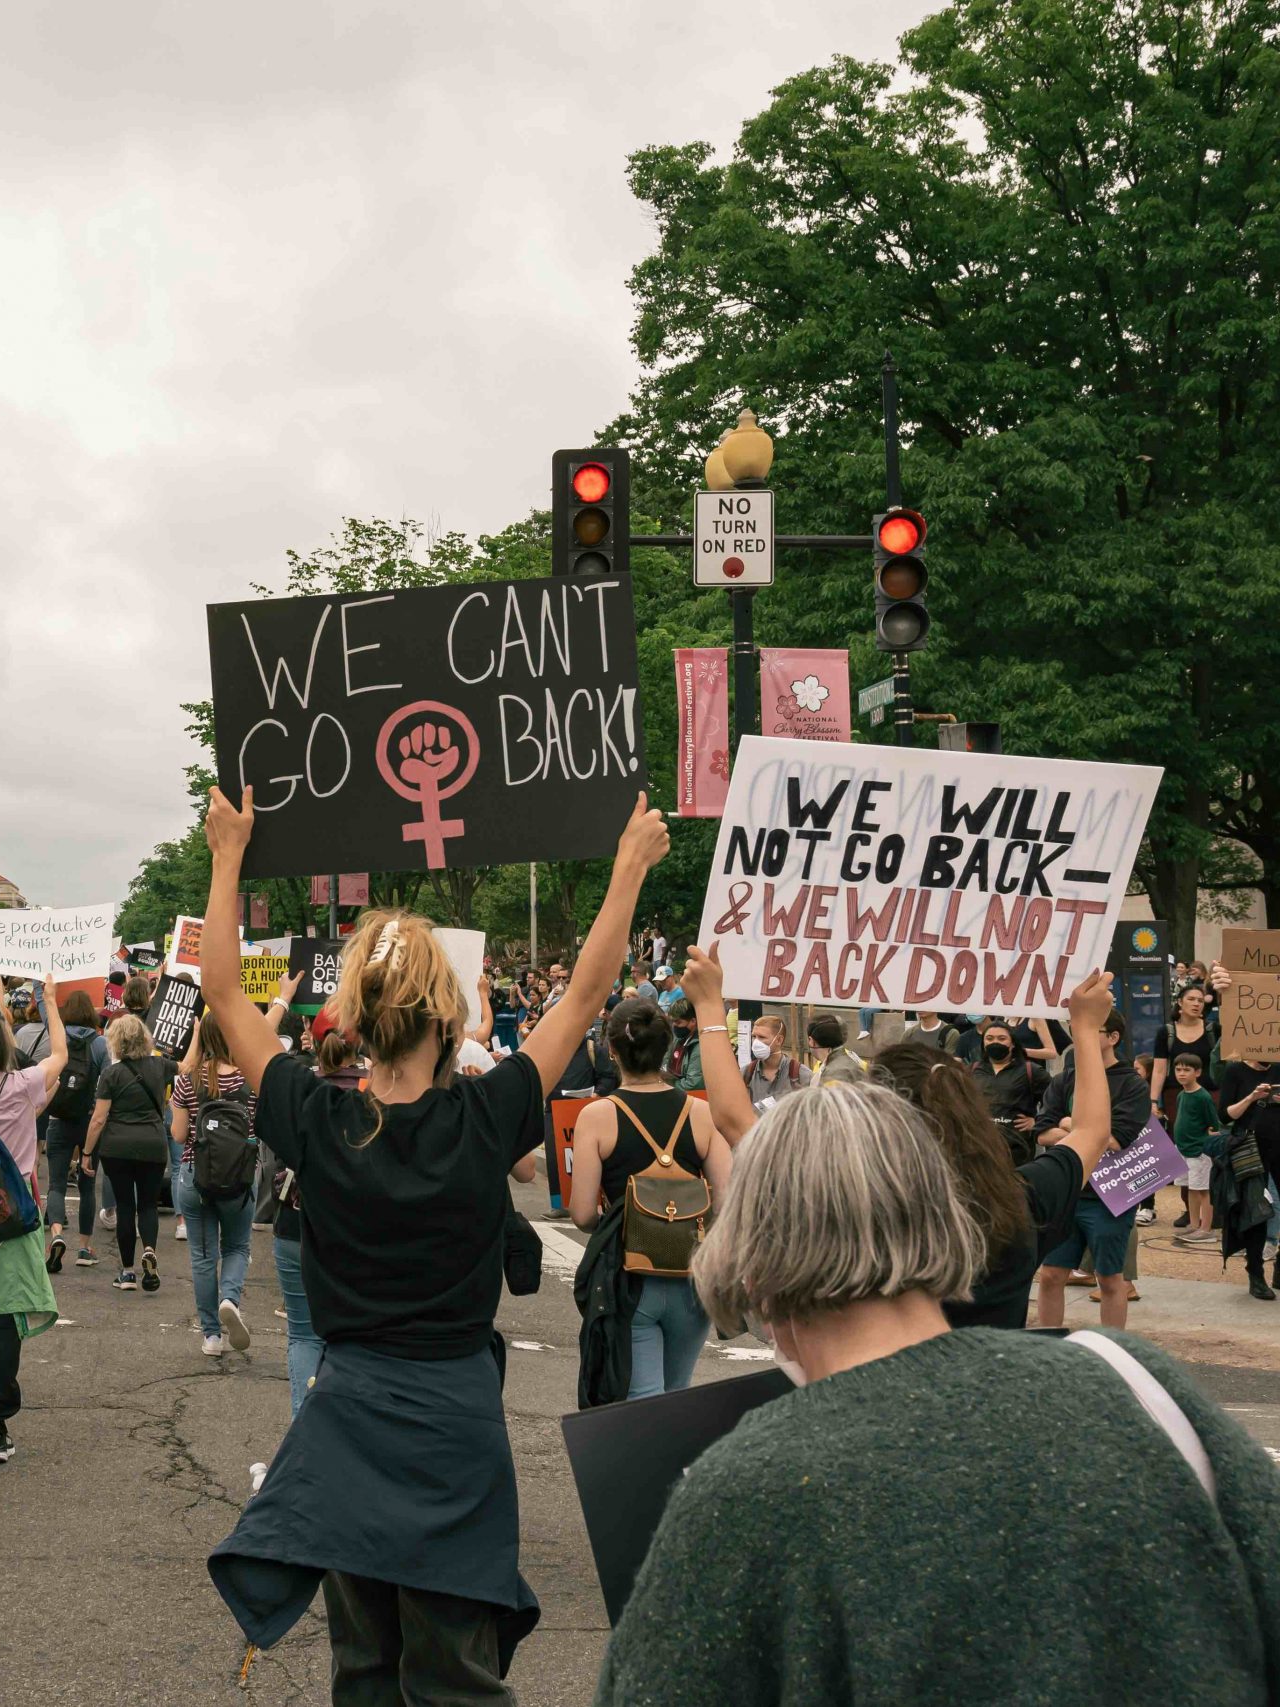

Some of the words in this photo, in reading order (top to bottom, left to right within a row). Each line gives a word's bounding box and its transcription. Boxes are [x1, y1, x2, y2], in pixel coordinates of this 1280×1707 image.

[719, 497, 751, 516] NO
[712, 520, 757, 535] TURN
[702, 539, 727, 554] ON
[733, 538, 766, 553] RED
[240, 595, 403, 709] WE
[448, 581, 620, 684] CAN'T
[685, 662, 693, 804] NationalCherryBlossomFestival.org
[773, 723, 803, 736] Cherry
[803, 724, 842, 734] Blossom
[239, 712, 351, 812] GO
[499, 684, 638, 786] BACK!
[787, 776, 893, 833] WE
[940, 785, 1077, 844] WILL
[723, 826, 831, 881] NOT
[840, 833, 906, 885] GO
[714, 881, 753, 936] &
[762, 883, 838, 940] WE
[847, 886, 971, 949] WILL
[979, 894, 1108, 956] NOT
[5, 936, 51, 949] RIGHTS
[61, 934, 89, 947] ARE
[51, 952, 96, 971] Rights
[314, 954, 344, 968] BAN
[760, 938, 899, 1004] BACK
[903, 945, 1070, 1008] DOWN.
[241, 983, 268, 995] IGHT
[251, 970, 257, 982] A
[261, 970, 285, 982] HUM
[165, 980, 199, 1008] HOW
[158, 1000, 194, 1029] DARE
[152, 1019, 187, 1050] THEY.
[1091, 1142, 1154, 1181] Pro-Justice.
[1099, 1156, 1160, 1193] Pro-Choice.
[1136, 1171, 1156, 1186] NARAL
